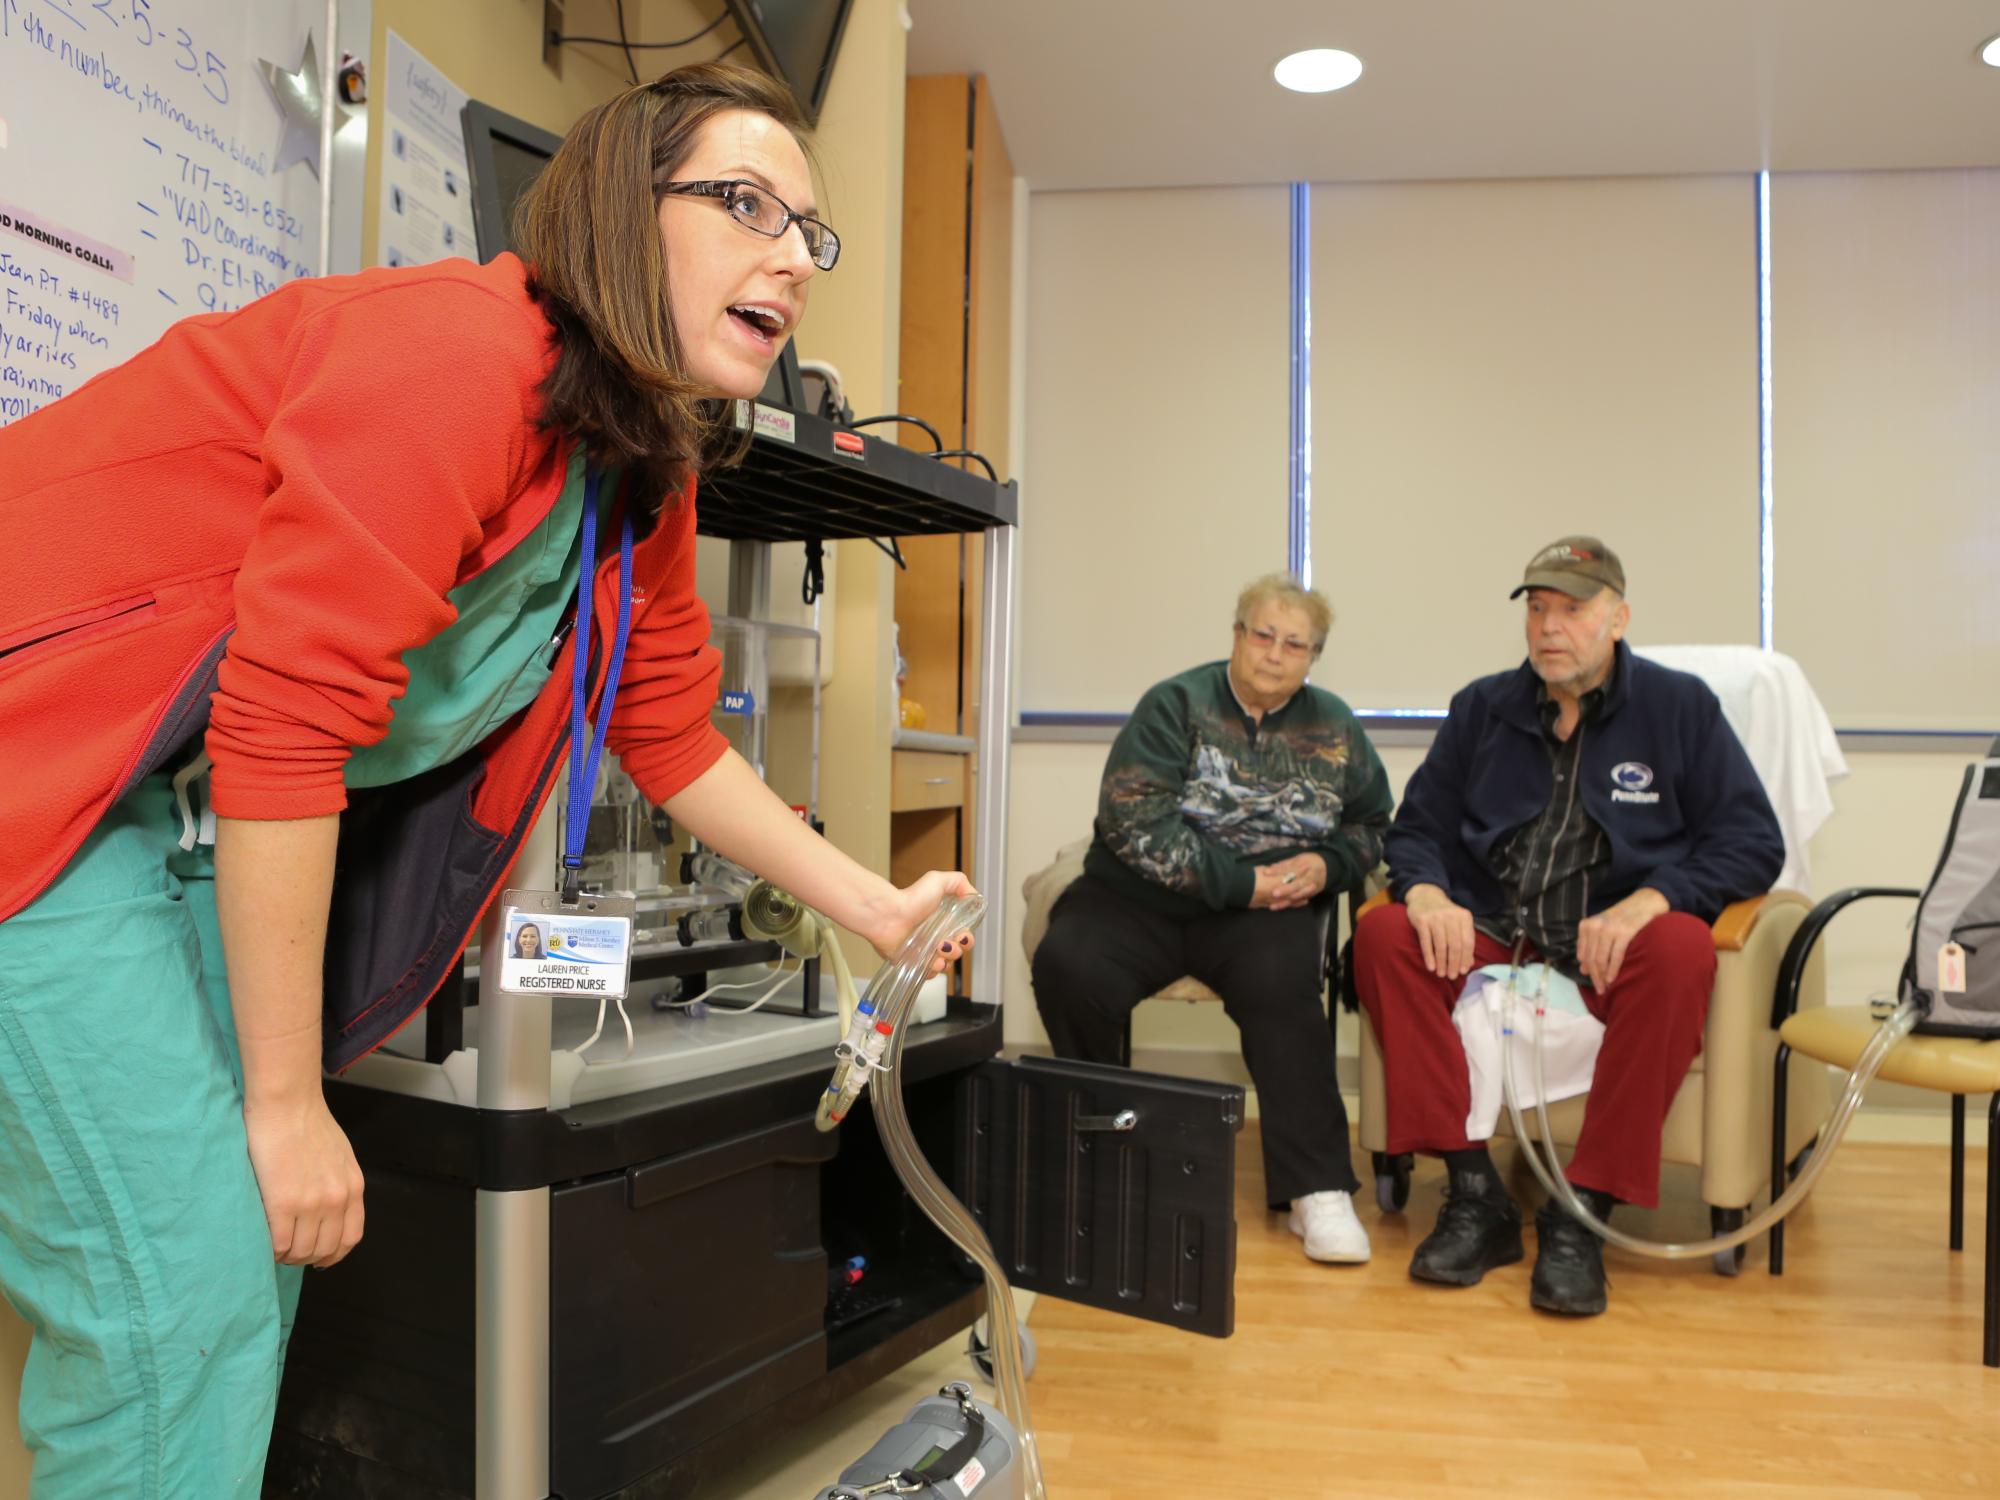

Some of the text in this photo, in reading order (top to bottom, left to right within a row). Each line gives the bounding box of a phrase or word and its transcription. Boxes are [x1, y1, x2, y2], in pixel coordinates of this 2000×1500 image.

[23, 11, 55, 53] the
[203, 123, 226, 153] the
[14, 218, 73, 255] MORNING
[182, 236, 217, 273] Dr.
[6, 286, 109, 350] Friday when
[68, 286, 119, 327] #4489
[16, 335, 77, 371] arrives
[725, 695, 745, 709] PAP
[519, 976, 607, 991] REGISTERED NURSE
[537, 964, 590, 976] LAUREN PRICE
